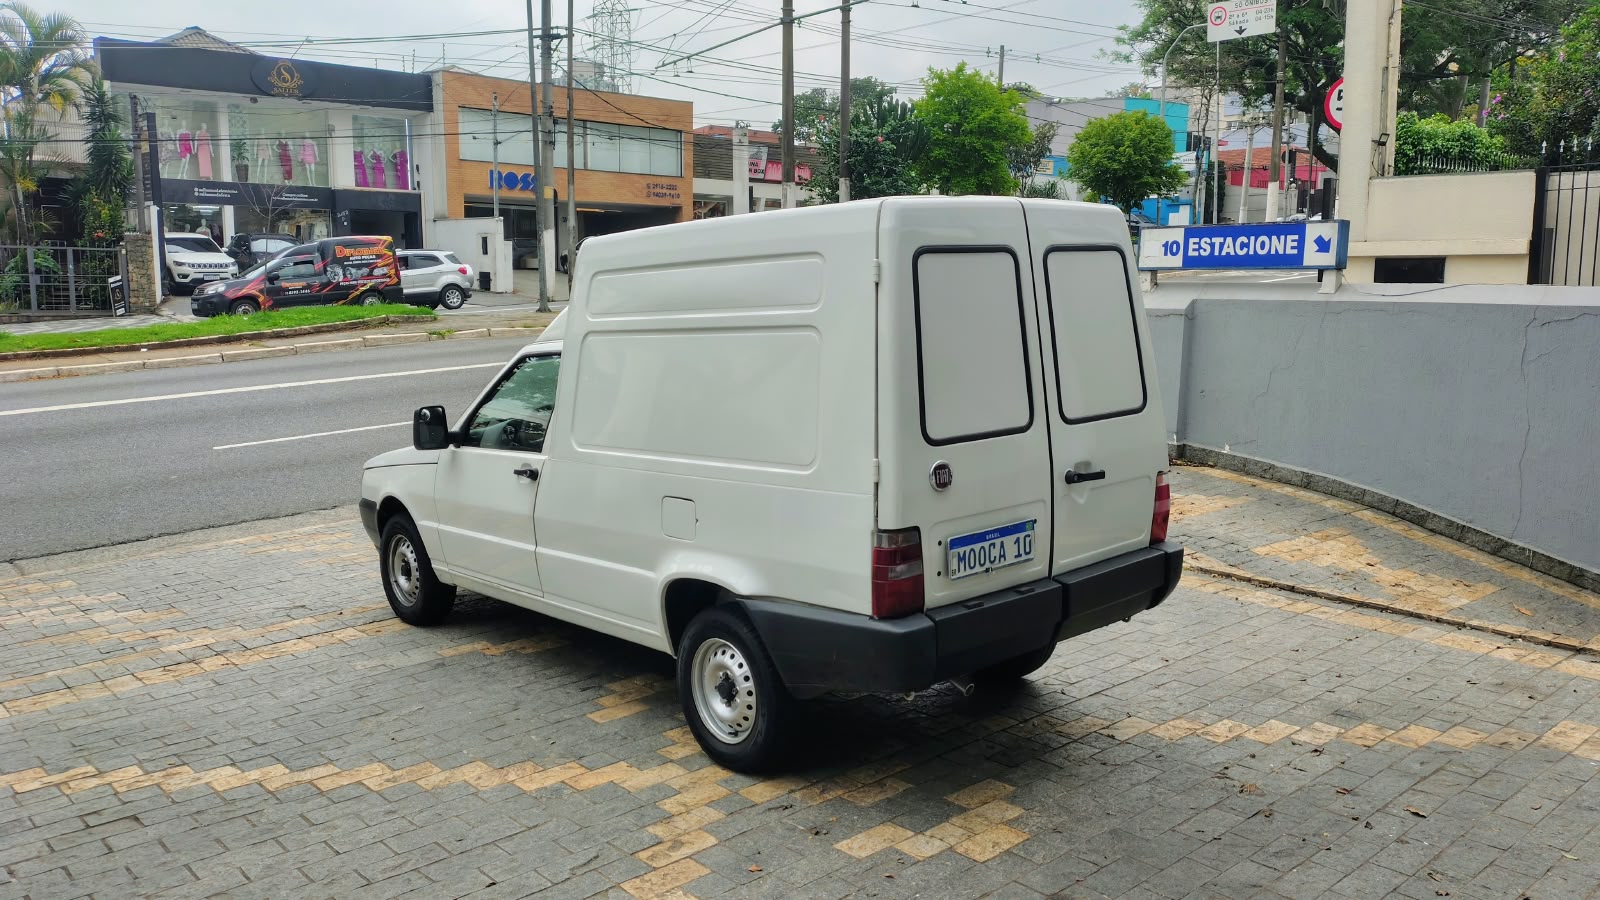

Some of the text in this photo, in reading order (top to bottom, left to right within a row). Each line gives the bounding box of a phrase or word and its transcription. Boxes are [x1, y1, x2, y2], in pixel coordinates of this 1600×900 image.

[1162, 234, 1299, 256] 10 ESTACIONE
[936, 468, 949, 484] FIAT
[957, 533, 1032, 574] MOOCA 10
